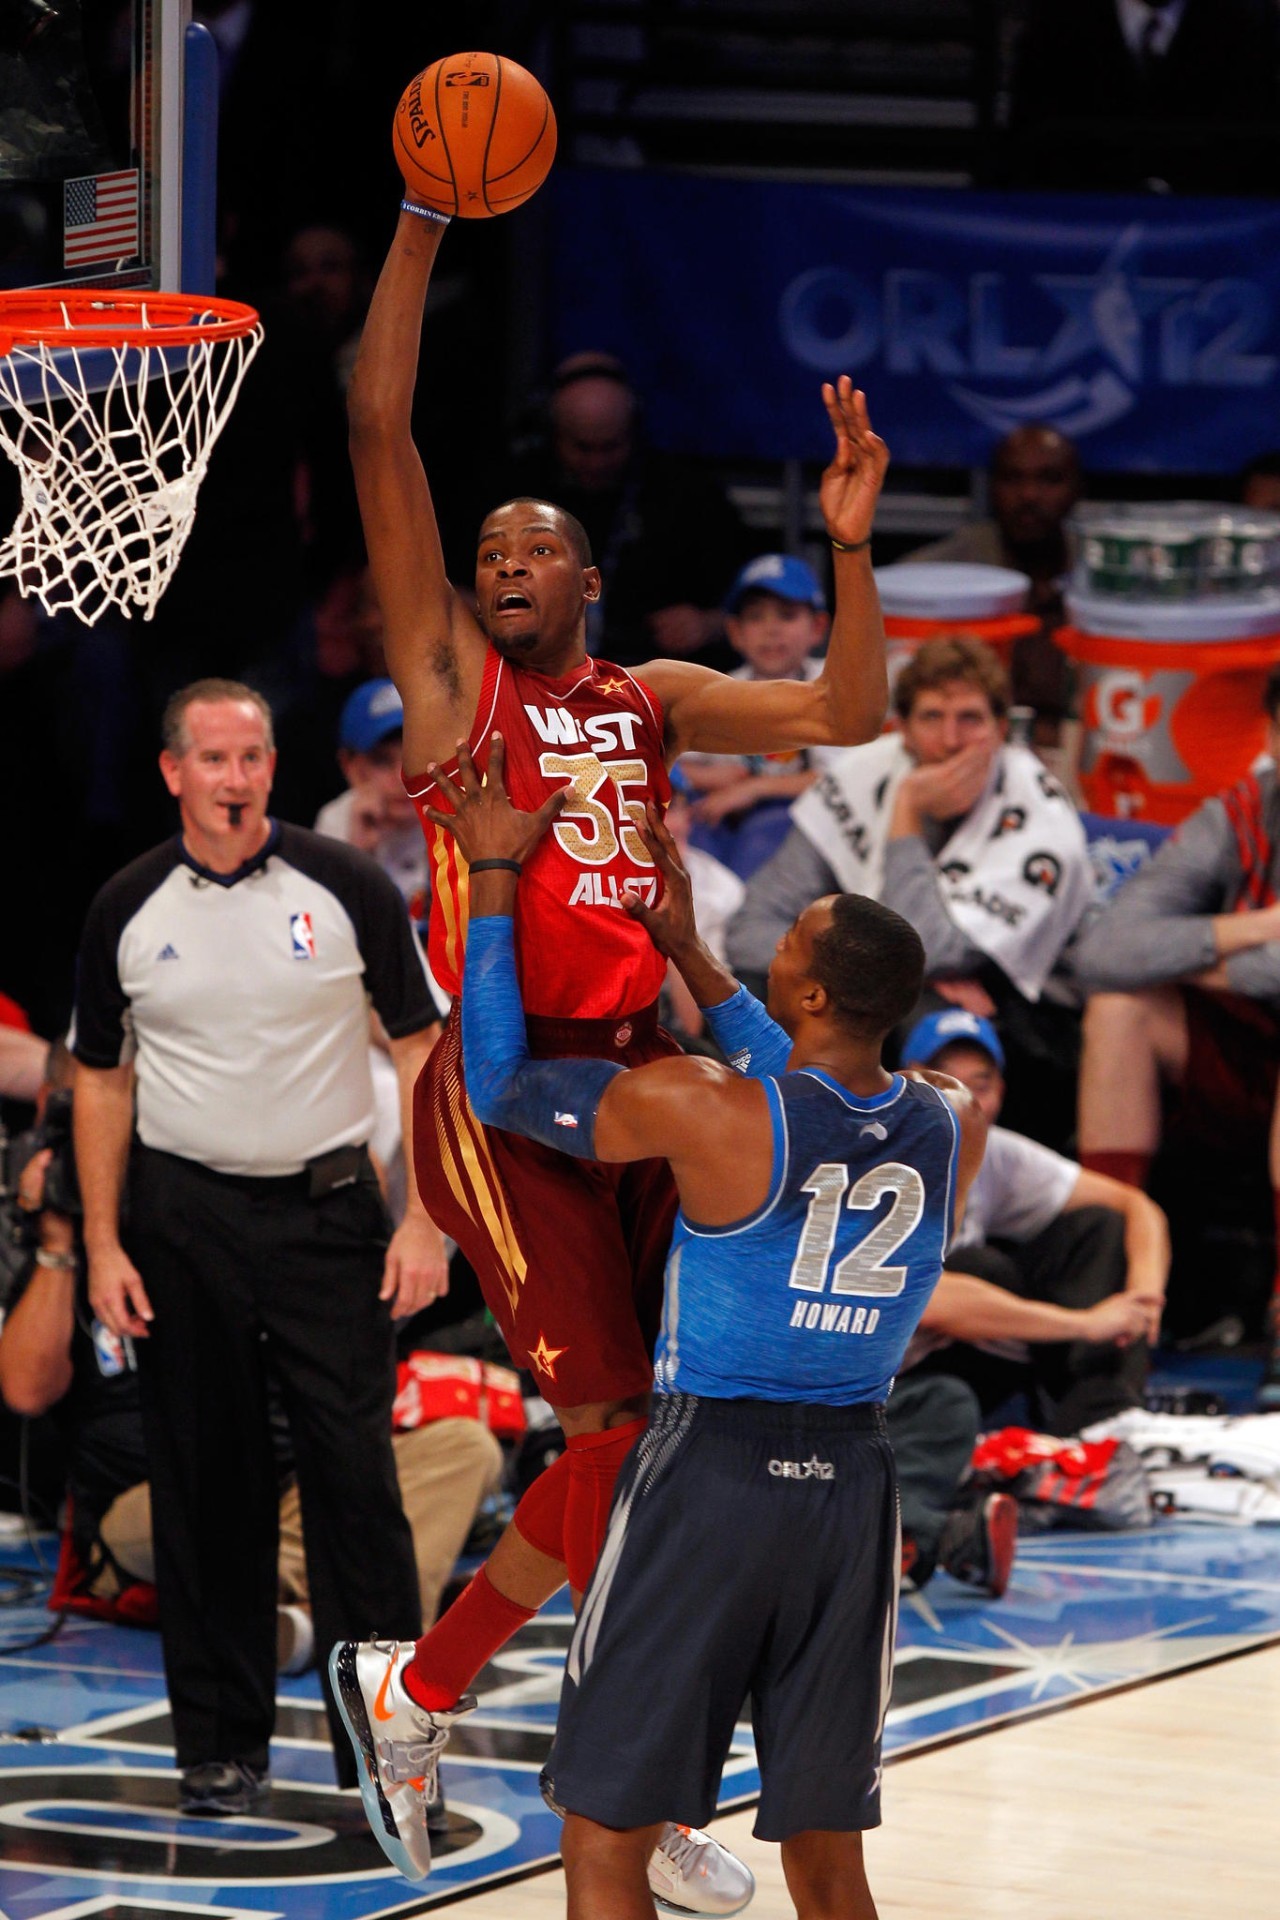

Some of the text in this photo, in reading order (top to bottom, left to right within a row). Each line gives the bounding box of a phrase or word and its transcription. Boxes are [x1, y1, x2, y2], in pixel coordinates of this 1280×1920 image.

[409, 66, 436, 149] SPALDI
[1097, 672, 1146, 732] G
[538, 752, 656, 867] 35
[789, 1162, 925, 1298] 12
[789, 1300, 880, 1335] HOWARD
